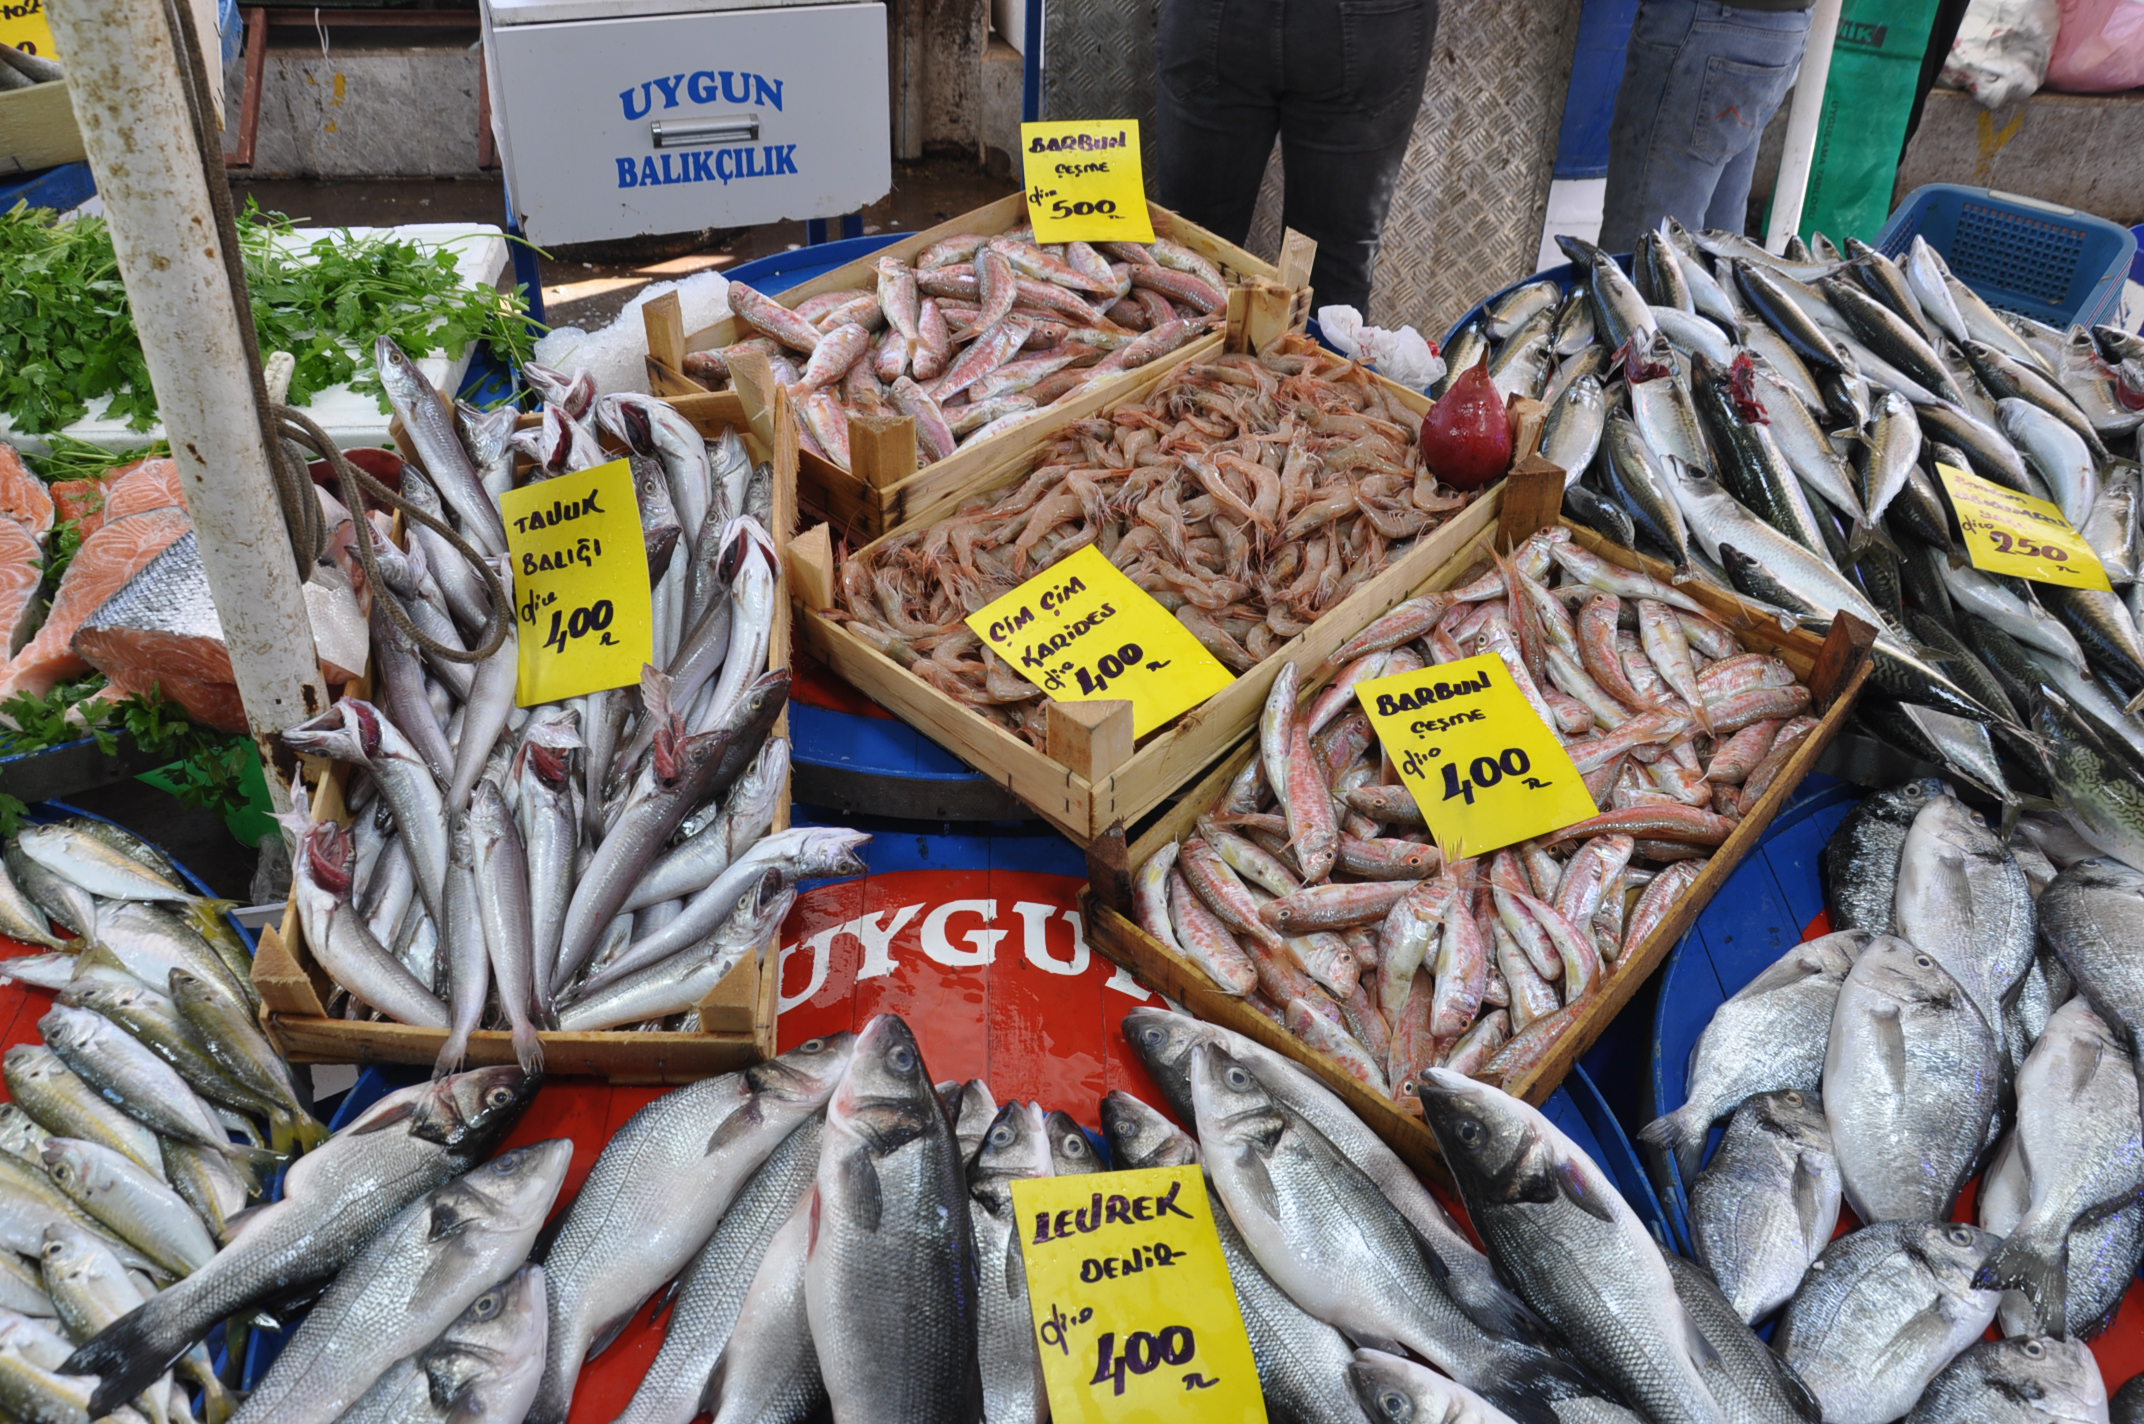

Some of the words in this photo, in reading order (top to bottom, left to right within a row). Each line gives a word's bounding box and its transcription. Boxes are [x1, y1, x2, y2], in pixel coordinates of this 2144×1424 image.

[619, 70, 783, 121] UYGUN
[615, 144, 798, 188] BALIKÇILIK
[1050, 199, 1117, 219] 500
[1989, 530, 2069, 562] 250
[543, 599, 614, 654] 400
[1073, 643, 1144, 696] 400
[1376, 670, 1492, 717] BARBUN
[1440, 747, 1531, 805] 400
[777, 898, 1153, 1015] UYGU
[1089, 1325, 1196, 1397] 400
